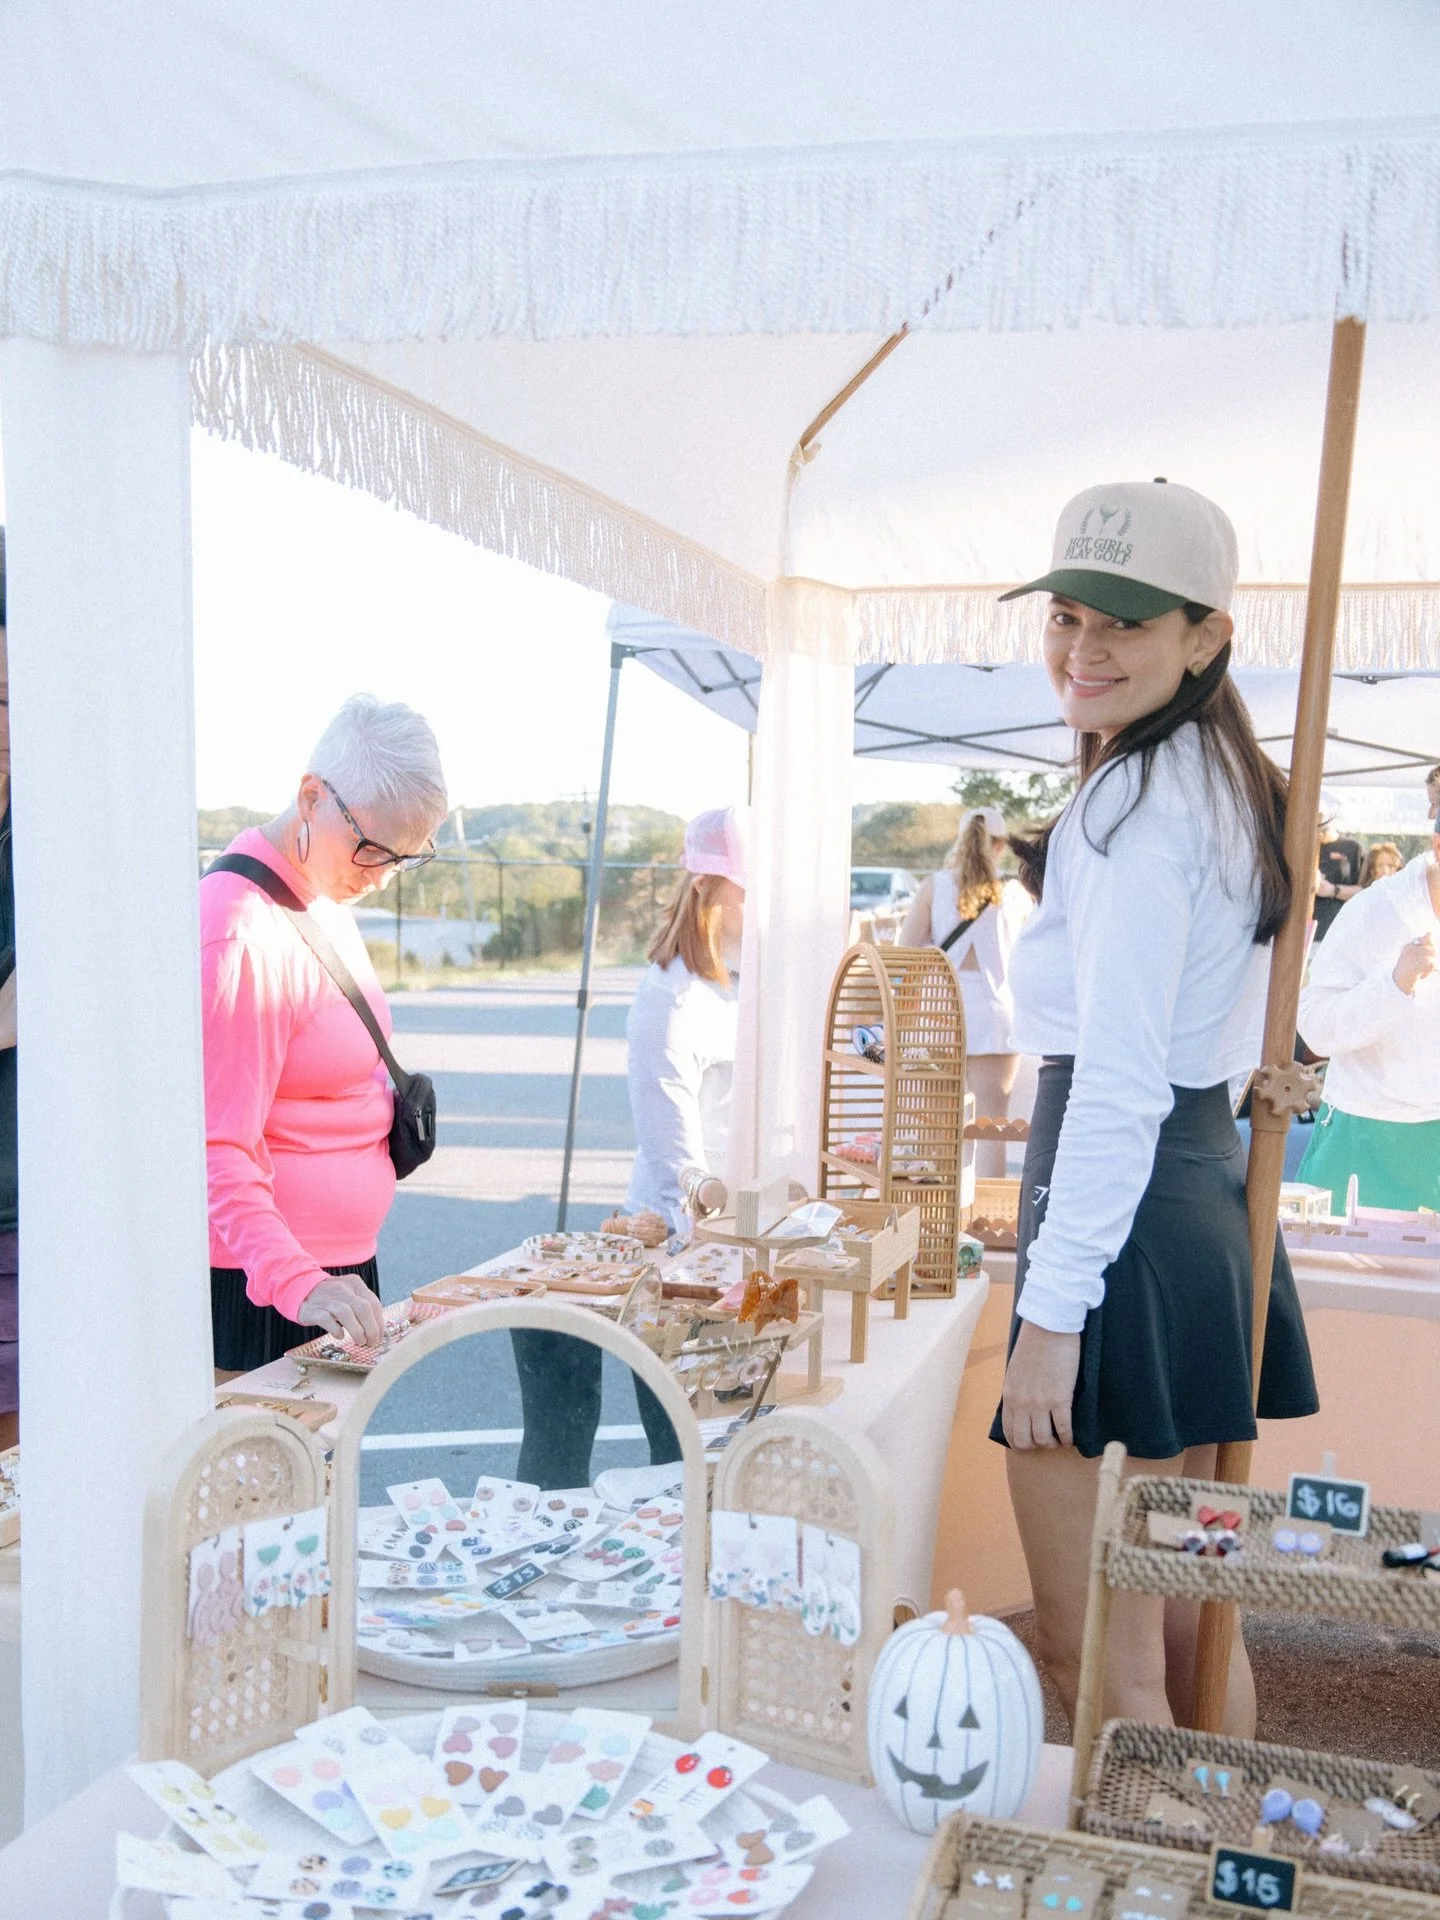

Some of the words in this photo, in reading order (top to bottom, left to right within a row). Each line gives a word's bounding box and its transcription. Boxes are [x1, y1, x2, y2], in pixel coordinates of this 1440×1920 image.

[1069, 536, 1093, 551] HOT
[1094, 537, 1133, 555] GIRLS
[1064, 546, 1093, 560] PLAY
[1094, 548, 1131, 566] GOLF
[1296, 1484, 1360, 1518] $16
